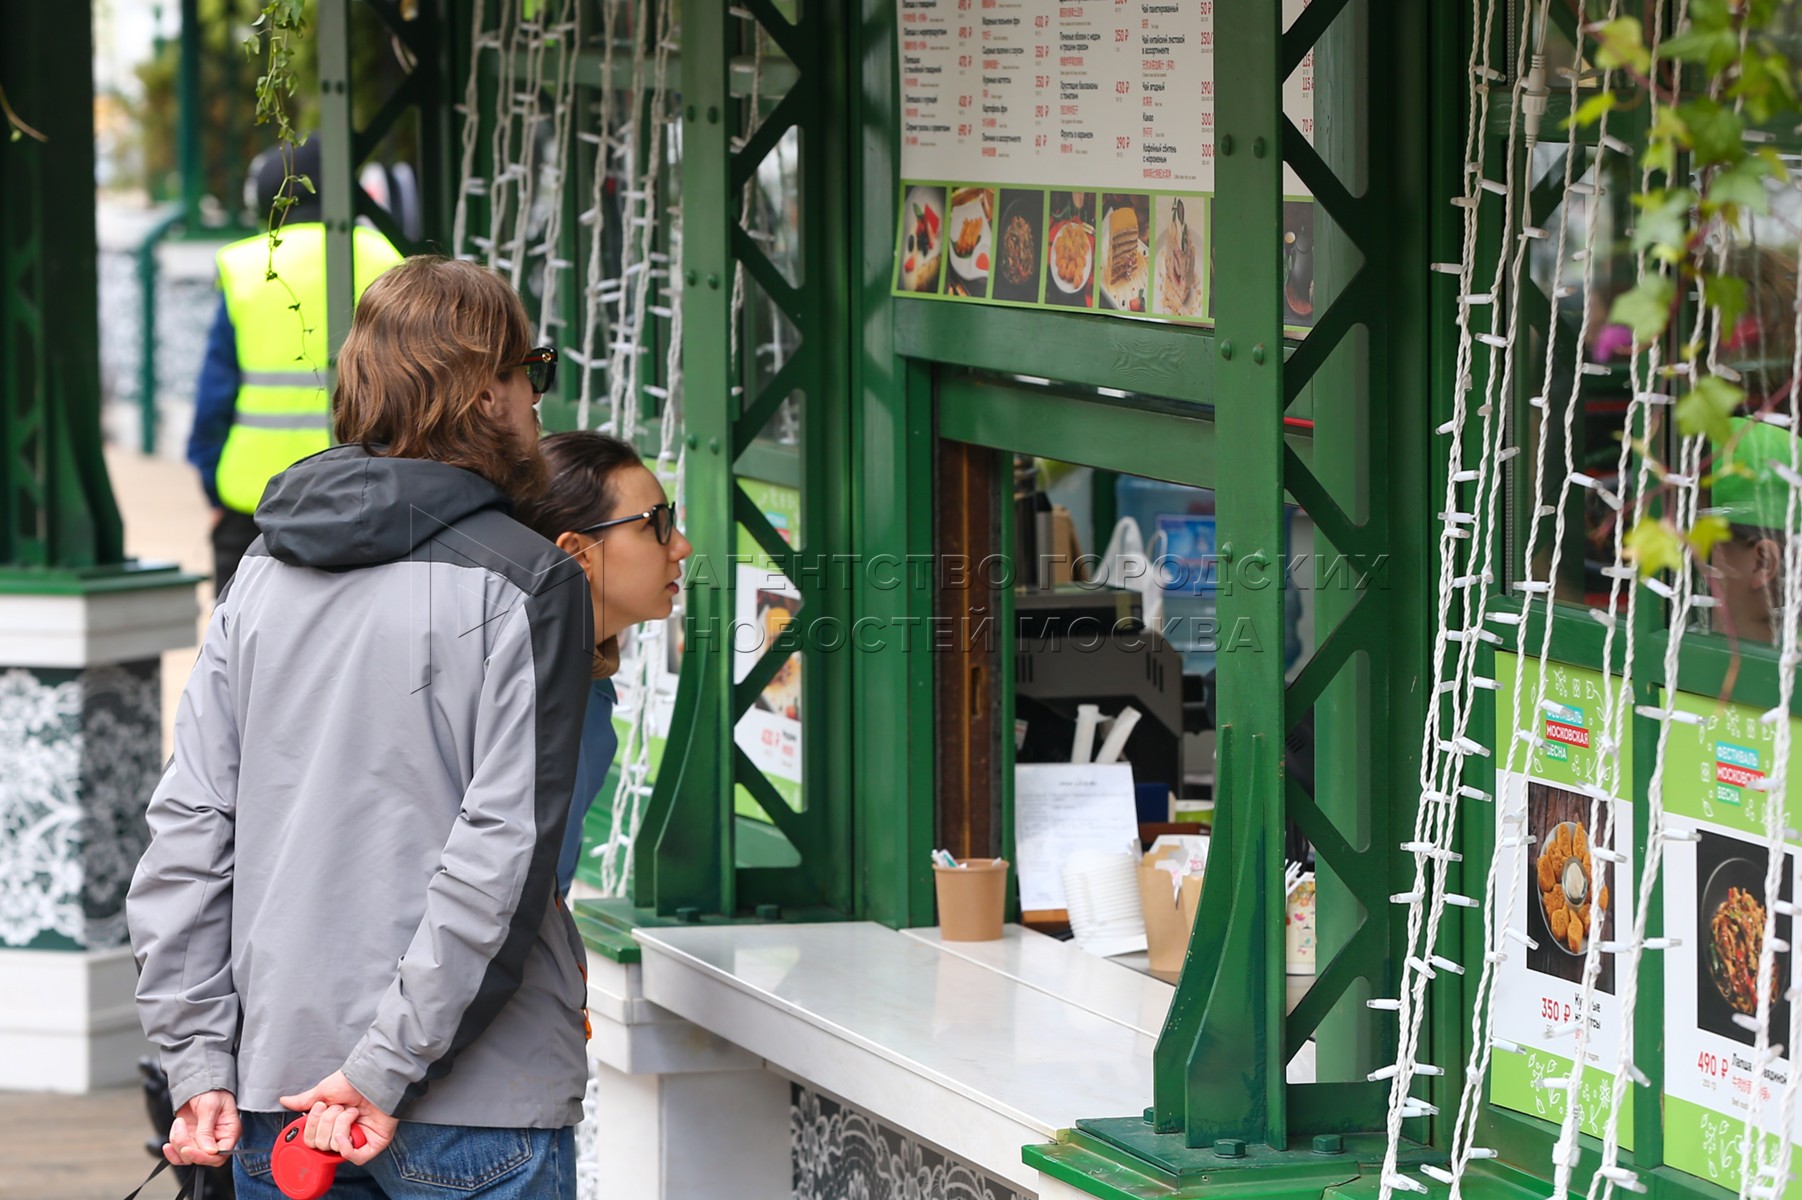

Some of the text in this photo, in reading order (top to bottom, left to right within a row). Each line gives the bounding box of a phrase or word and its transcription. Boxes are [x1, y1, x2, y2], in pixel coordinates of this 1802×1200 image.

[1546, 724, 1589, 745] МОСКОВСКАЯ
[1717, 745, 1758, 767] ФЕСТИВАЛЬ
[1718, 785, 1741, 803] ВЕСНА
[1541, 997, 1559, 1022] 350
[1697, 1051, 1717, 1076] 490
